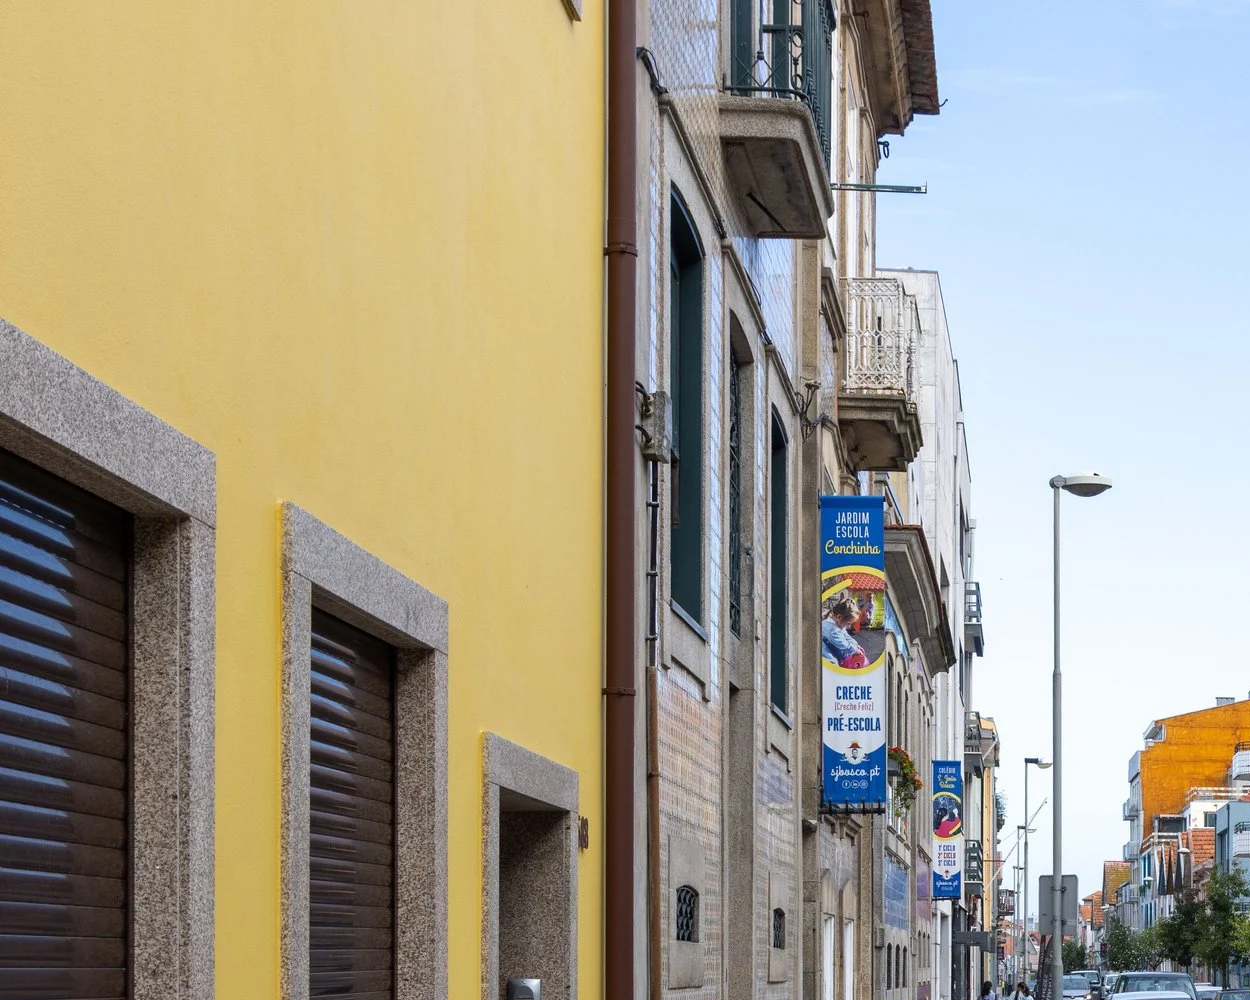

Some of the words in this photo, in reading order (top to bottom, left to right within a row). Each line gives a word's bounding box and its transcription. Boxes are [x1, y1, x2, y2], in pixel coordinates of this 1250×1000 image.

[836, 512, 869, 524] JARDIM
[836, 526, 869, 538] ESCOLA
[825, 540, 880, 554] Conchinha
[836, 686, 872, 700] CRECHE
[828, 713, 881, 731] PRÉ-ESCOLA
[831, 765, 880, 781] sjbosco.pt
